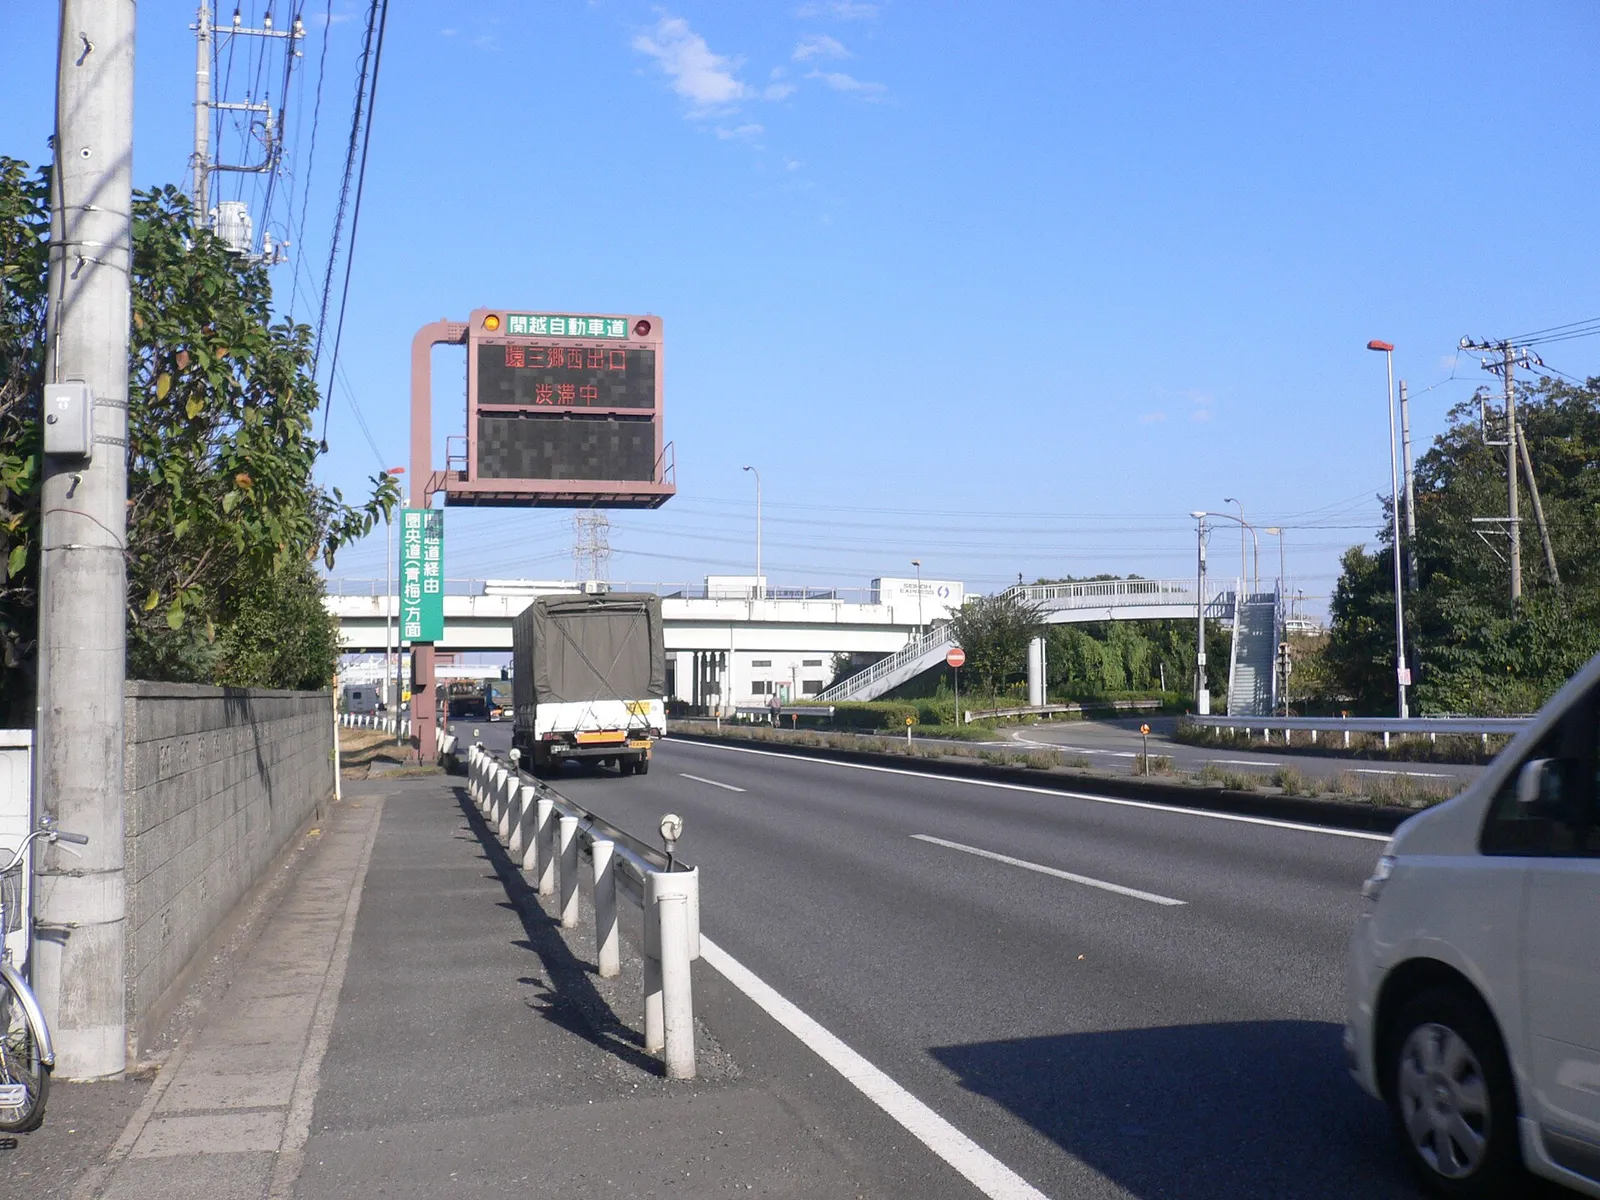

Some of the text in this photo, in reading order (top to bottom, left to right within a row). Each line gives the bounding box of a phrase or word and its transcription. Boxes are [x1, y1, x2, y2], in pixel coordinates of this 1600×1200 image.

[509, 315, 625, 337] 関越自動車道
[535, 383, 599, 406] 渋滞中
